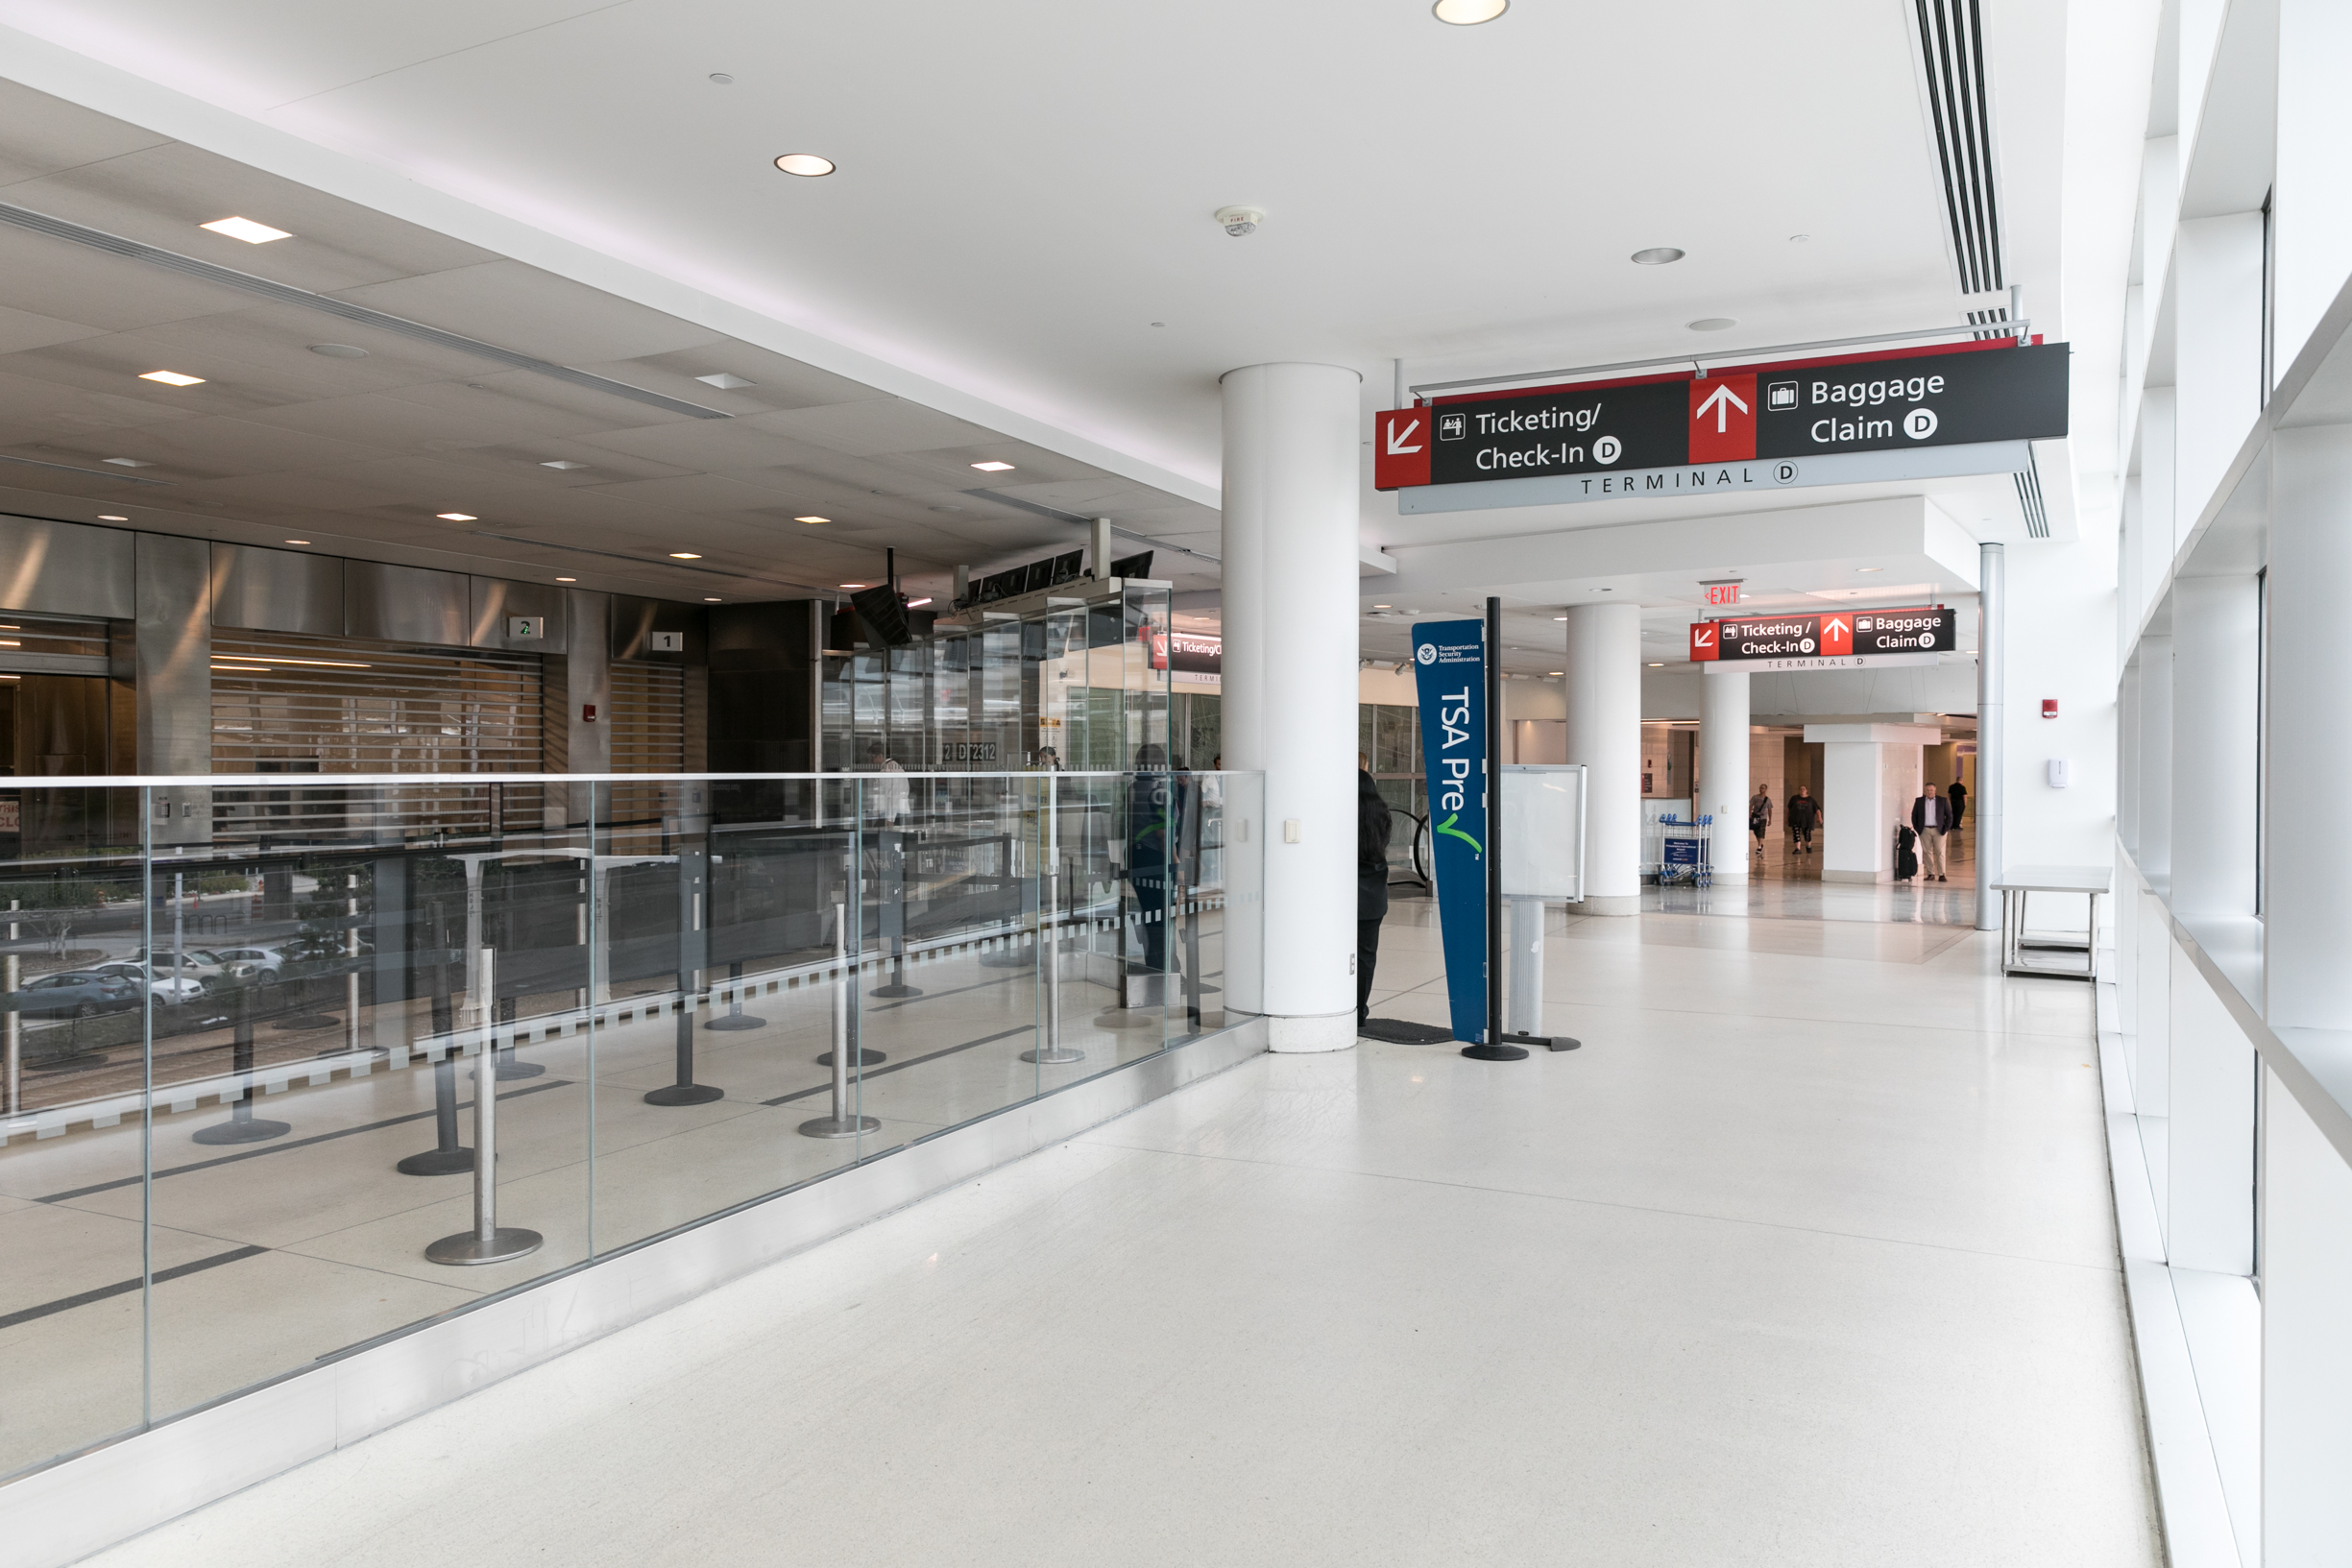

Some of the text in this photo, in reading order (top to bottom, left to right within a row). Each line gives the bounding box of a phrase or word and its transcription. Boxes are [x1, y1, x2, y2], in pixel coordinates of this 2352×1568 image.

[1810, 373, 1945, 407] Baggage
[1476, 403, 1602, 437] Ticketing/
[1810, 419, 1894, 445] Claim
[1475, 439, 1585, 470] Check-In
[1582, 470, 1753, 495] TERMINAL
[1710, 586, 1739, 605] EXIT
[521, 620, 530, 635] 2
[1877, 617, 1941, 631] Baggage
[664, 635, 670, 647] 1
[1741, 641, 1799, 655] Check-In
[1877, 635, 1918, 648] Claim
[1767, 660, 1846, 668] TERMINAL
[1442, 686, 1470, 811] TSA Pre
